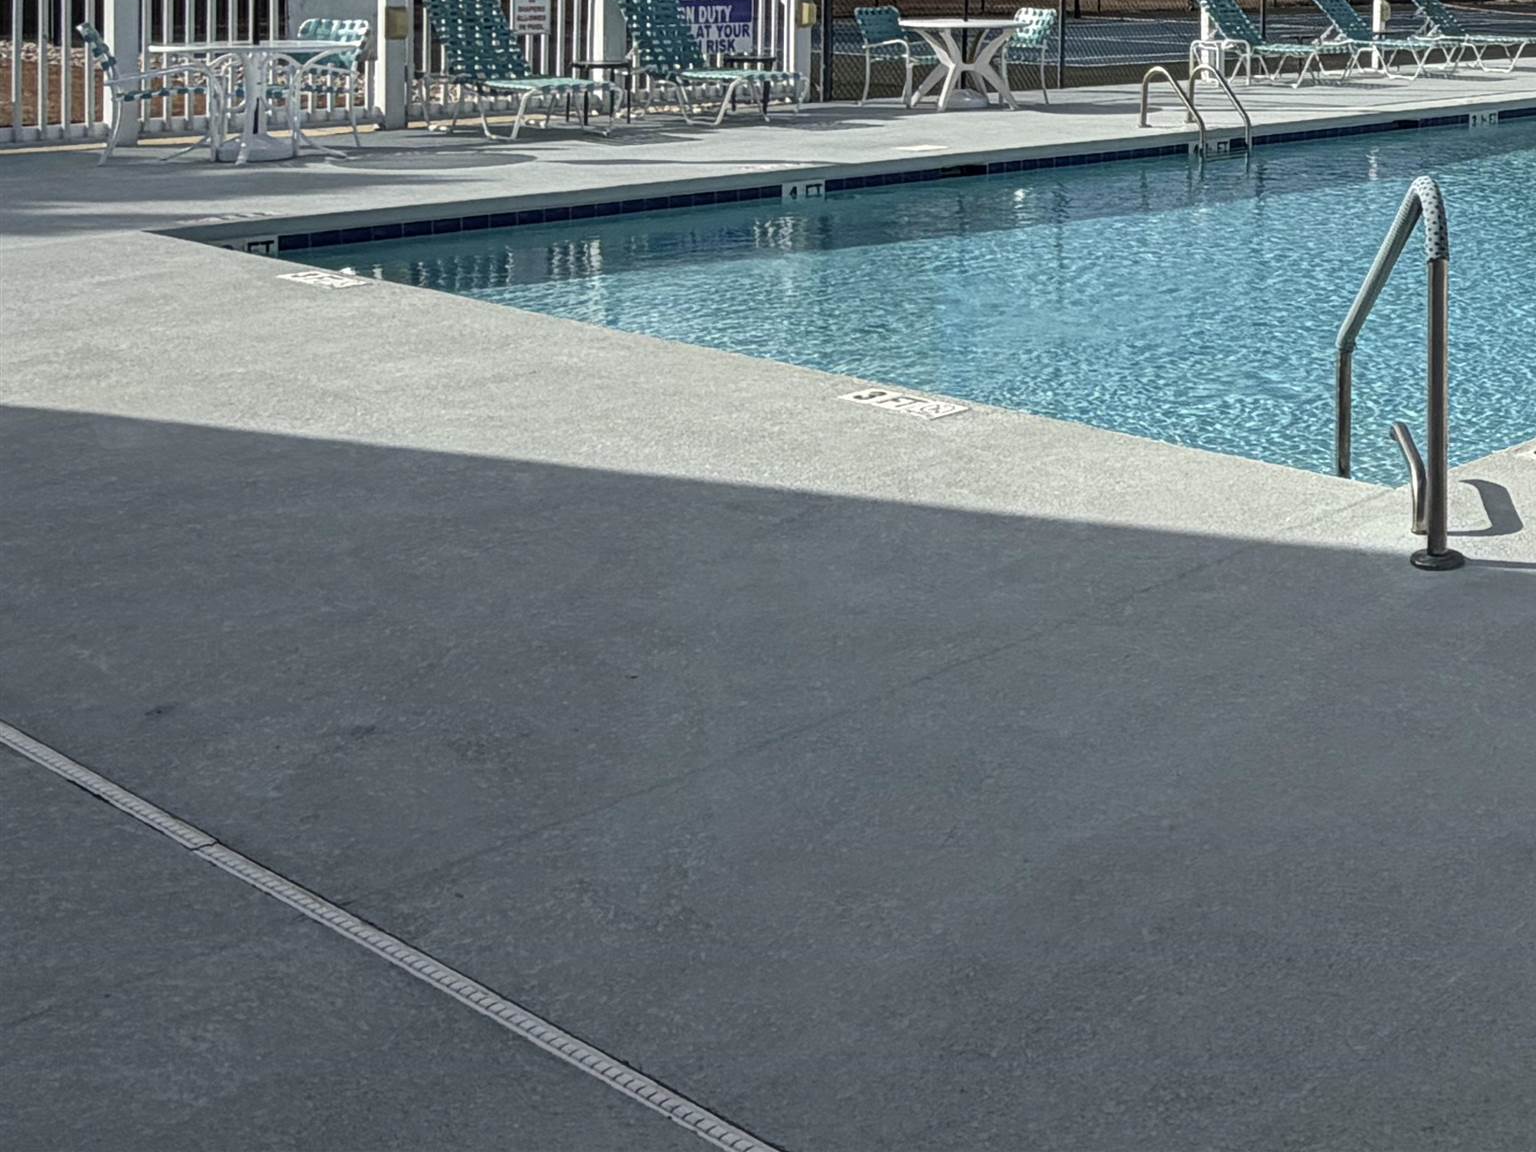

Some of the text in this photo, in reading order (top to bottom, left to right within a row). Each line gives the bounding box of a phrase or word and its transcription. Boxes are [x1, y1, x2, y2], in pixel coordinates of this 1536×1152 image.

[698, 5, 733, 23] DUTY
[696, 24, 751, 38] AT YOUR
[706, 39, 736, 53] RISK
[805, 183, 823, 197] FT
